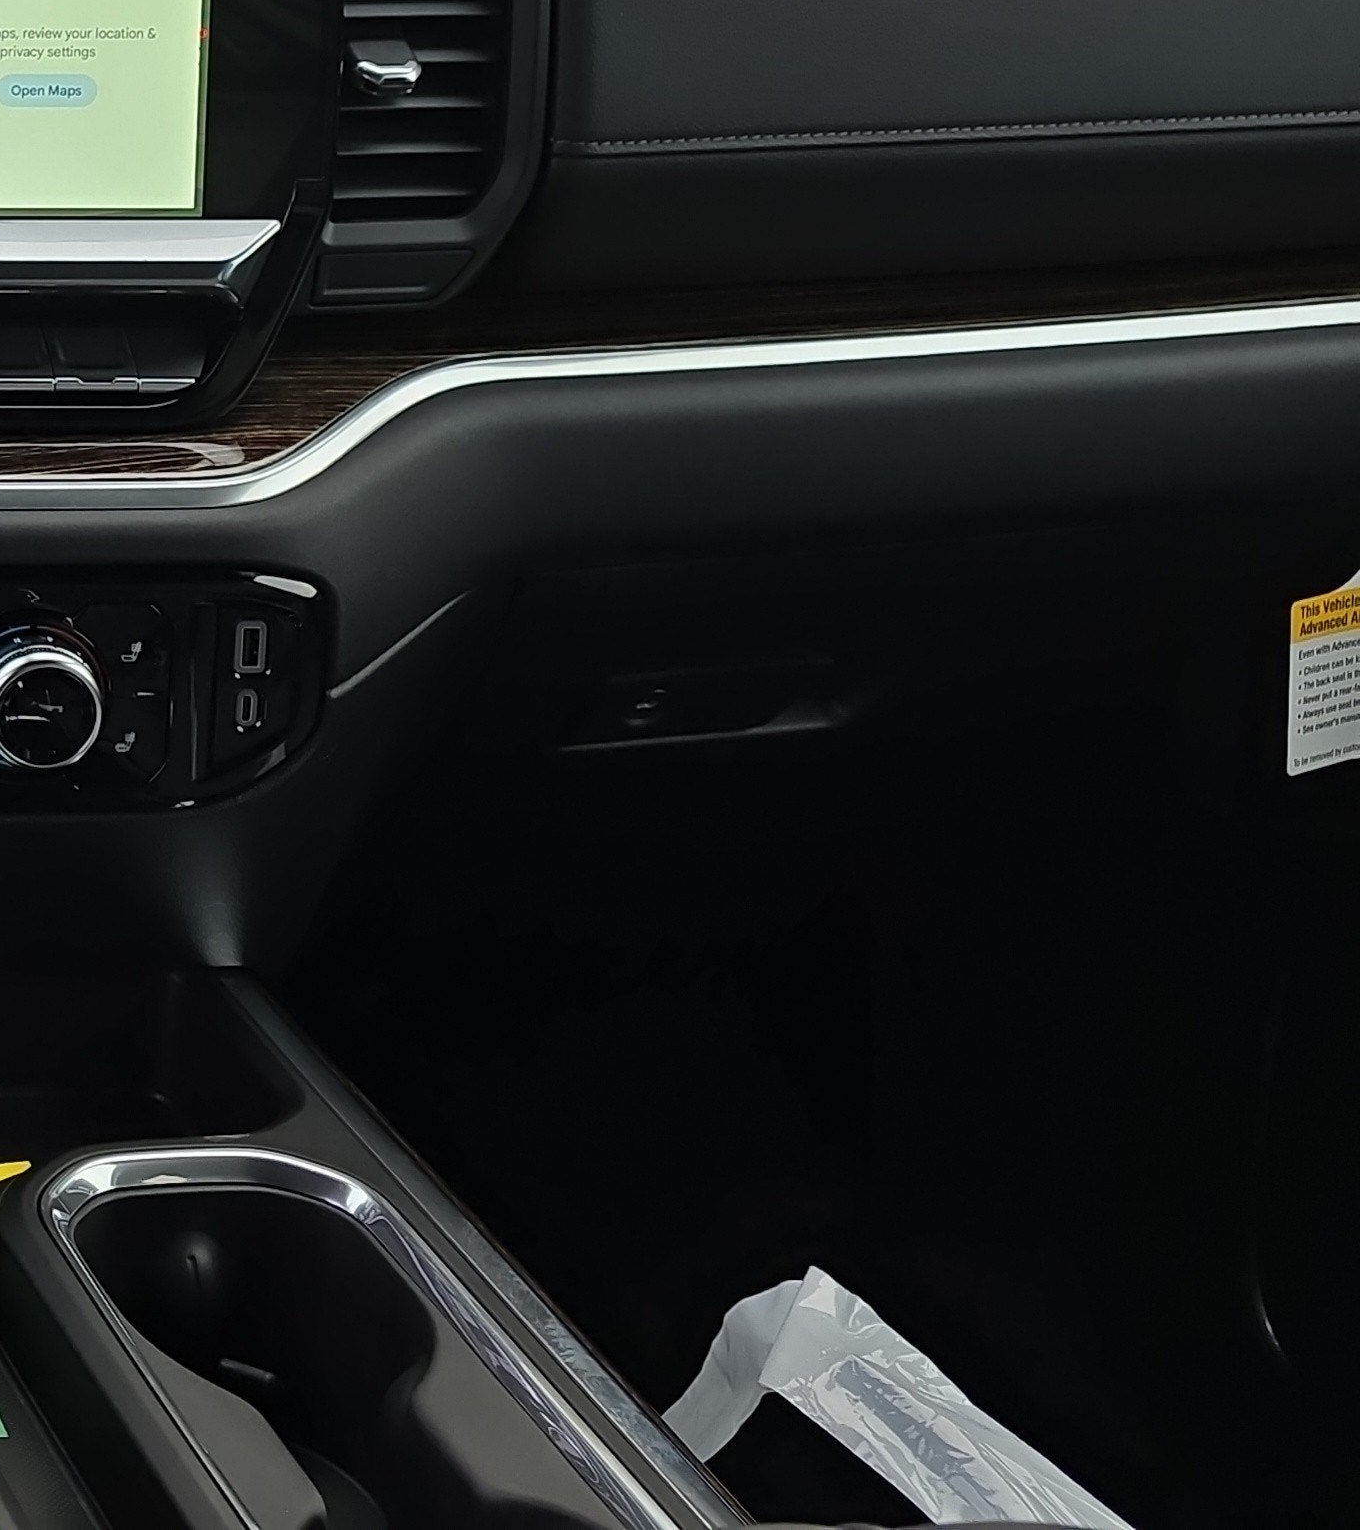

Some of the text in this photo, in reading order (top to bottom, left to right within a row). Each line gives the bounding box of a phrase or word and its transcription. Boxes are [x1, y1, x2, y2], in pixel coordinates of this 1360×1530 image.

[22, 28, 62, 40] review
[65, 31, 92, 44] your
[95, 27, 144, 40] location
[147, 28, 157, 40] &
[0, 45, 96, 60] privacy settings
[11, 83, 82, 97] Open Maps
[1301, 601, 1321, 620] This
[1300, 613, 1348, 637] Advanced
